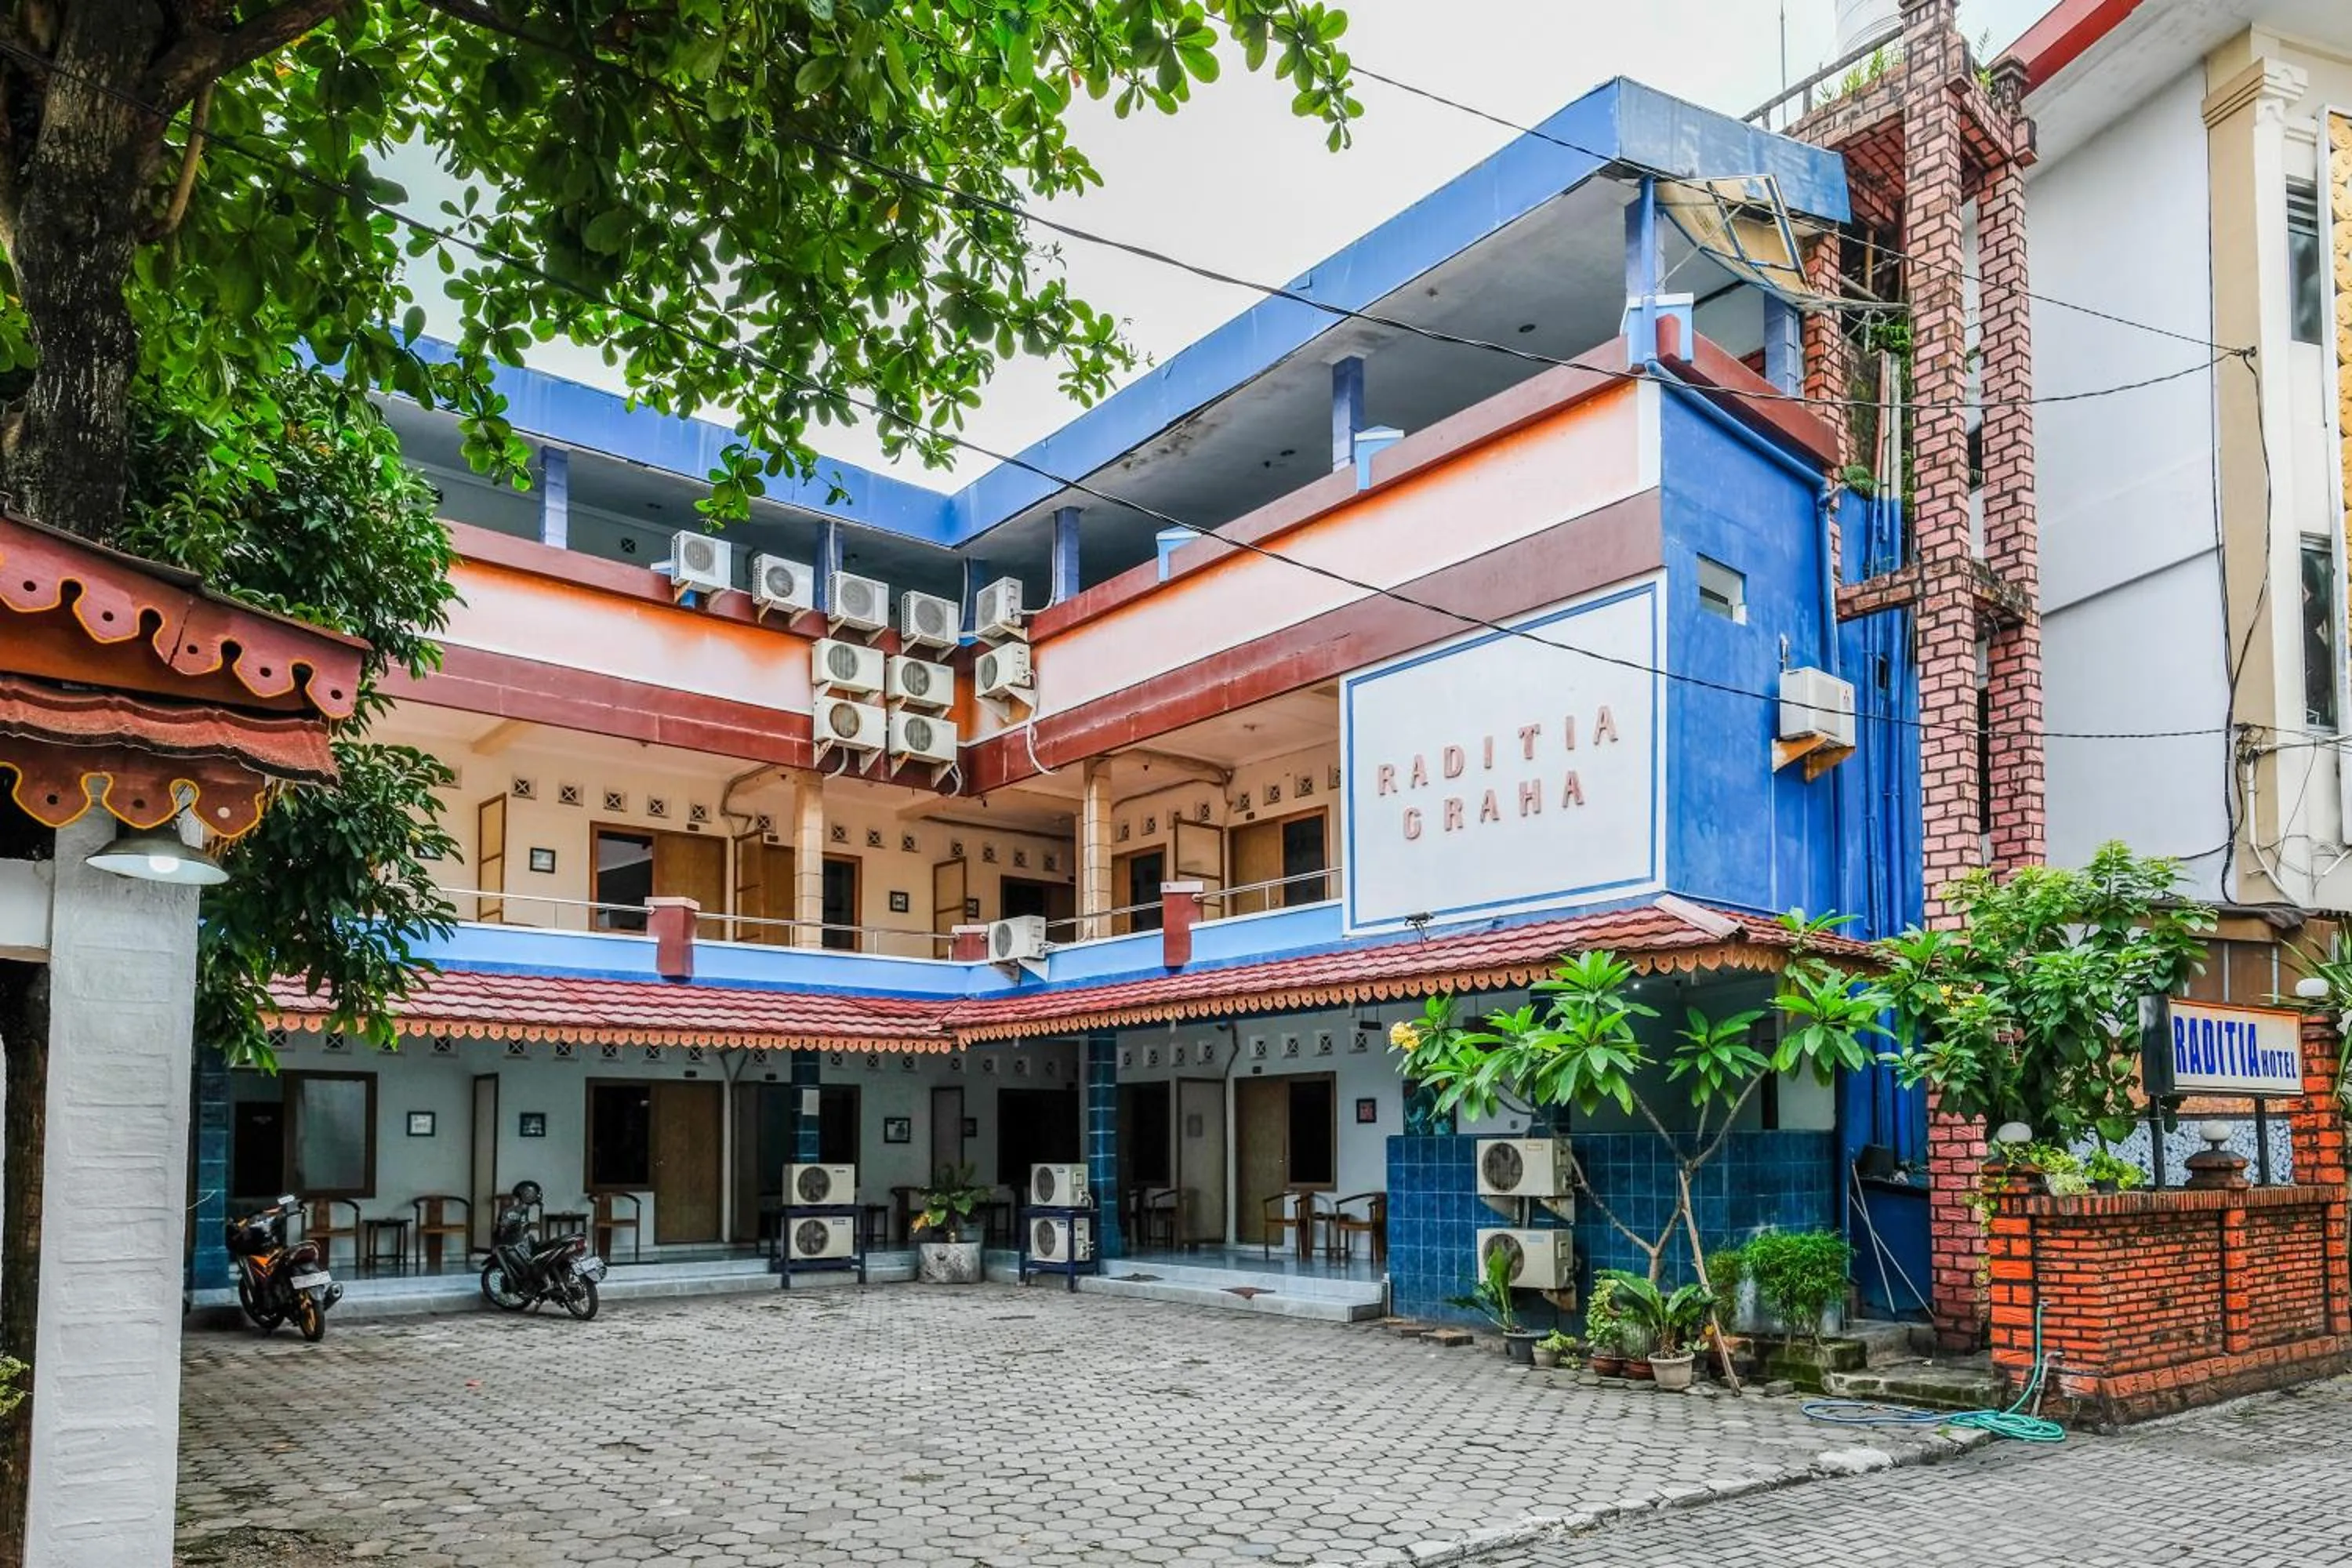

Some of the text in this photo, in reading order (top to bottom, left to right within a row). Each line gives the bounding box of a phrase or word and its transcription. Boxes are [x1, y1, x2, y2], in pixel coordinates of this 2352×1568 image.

[1377, 706, 1618, 796] RADITIA
[1403, 770, 1584, 840] GRAHA
[2173, 1016, 2296, 1079] RADITIA HOTEL
